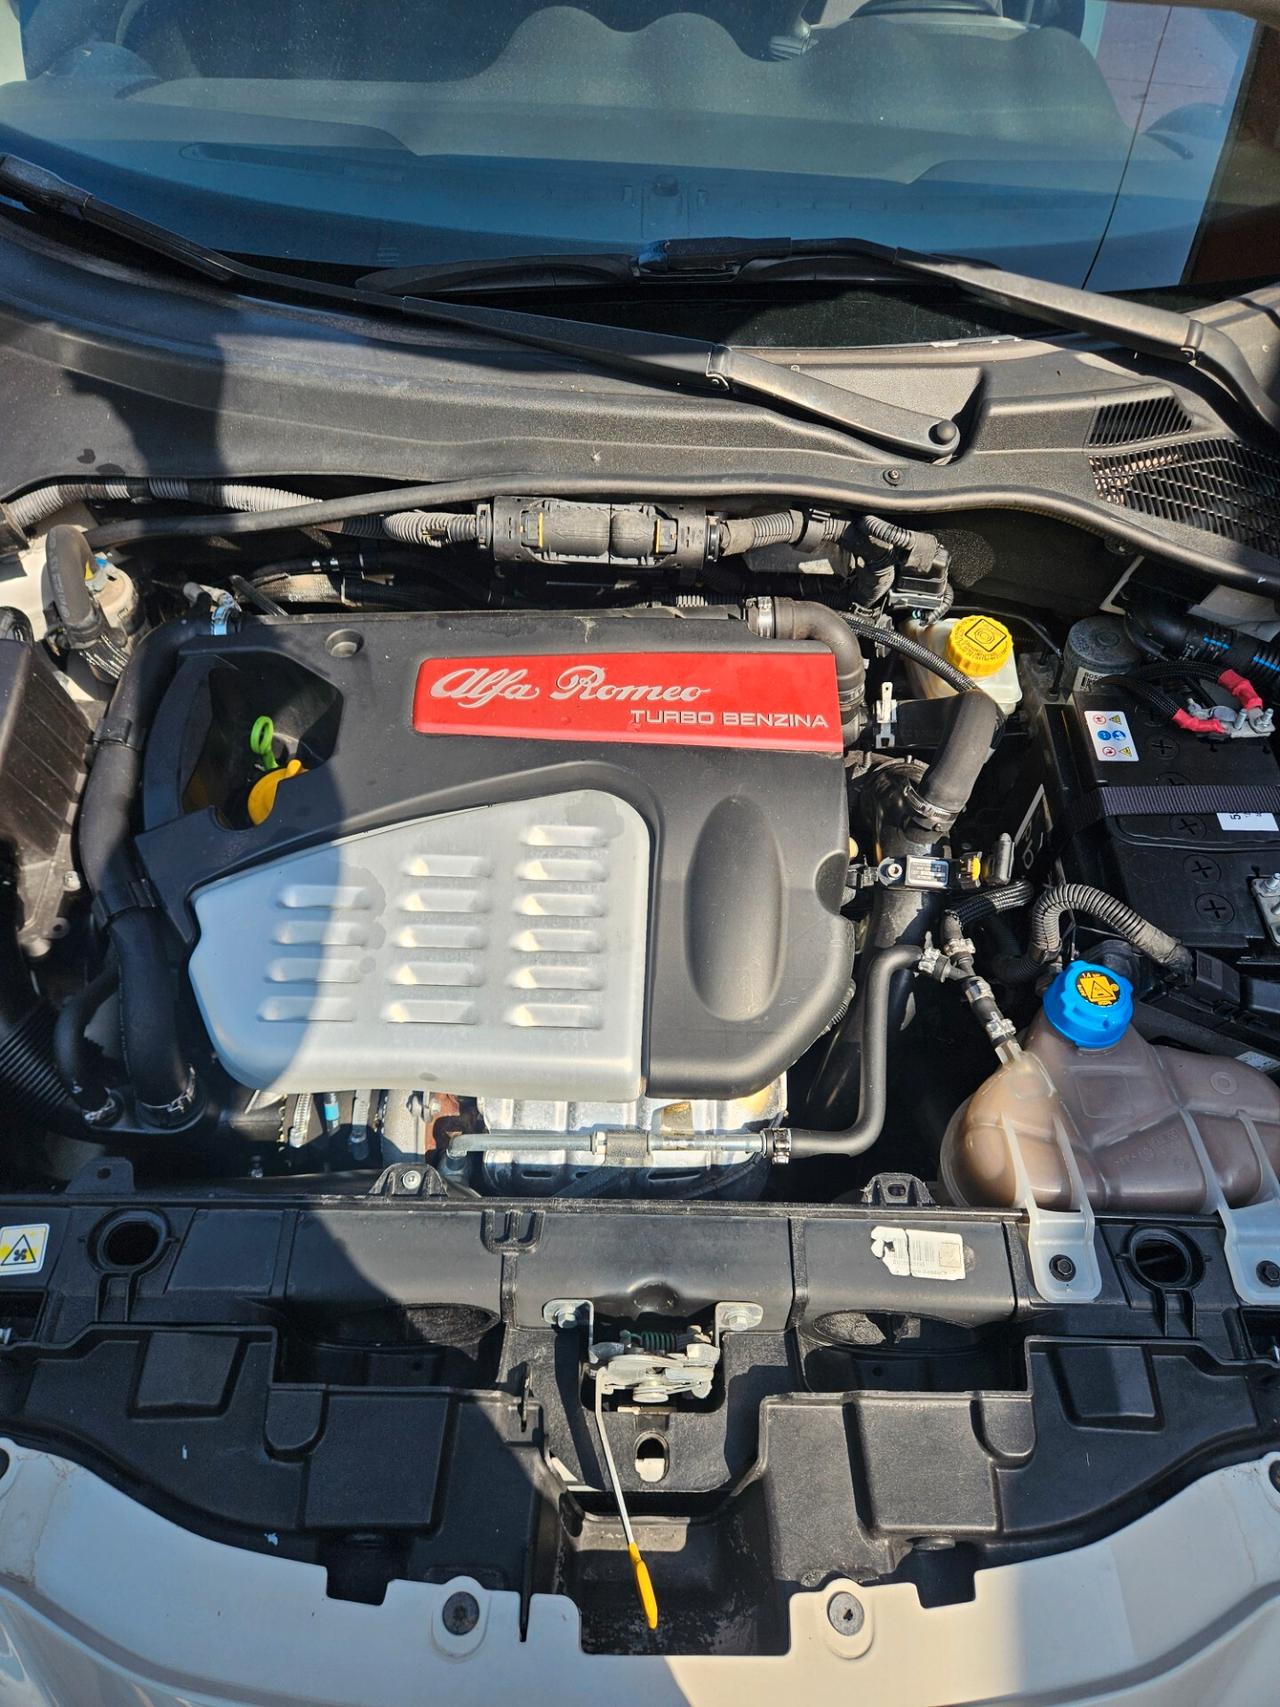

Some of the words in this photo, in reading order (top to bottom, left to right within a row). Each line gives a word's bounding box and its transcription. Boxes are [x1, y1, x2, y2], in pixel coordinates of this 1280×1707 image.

[430, 668, 540, 708] Alfa
[550, 665, 711, 701] Romeo
[631, 710, 715, 724] TURBO
[723, 712, 829, 728] BENZINA
